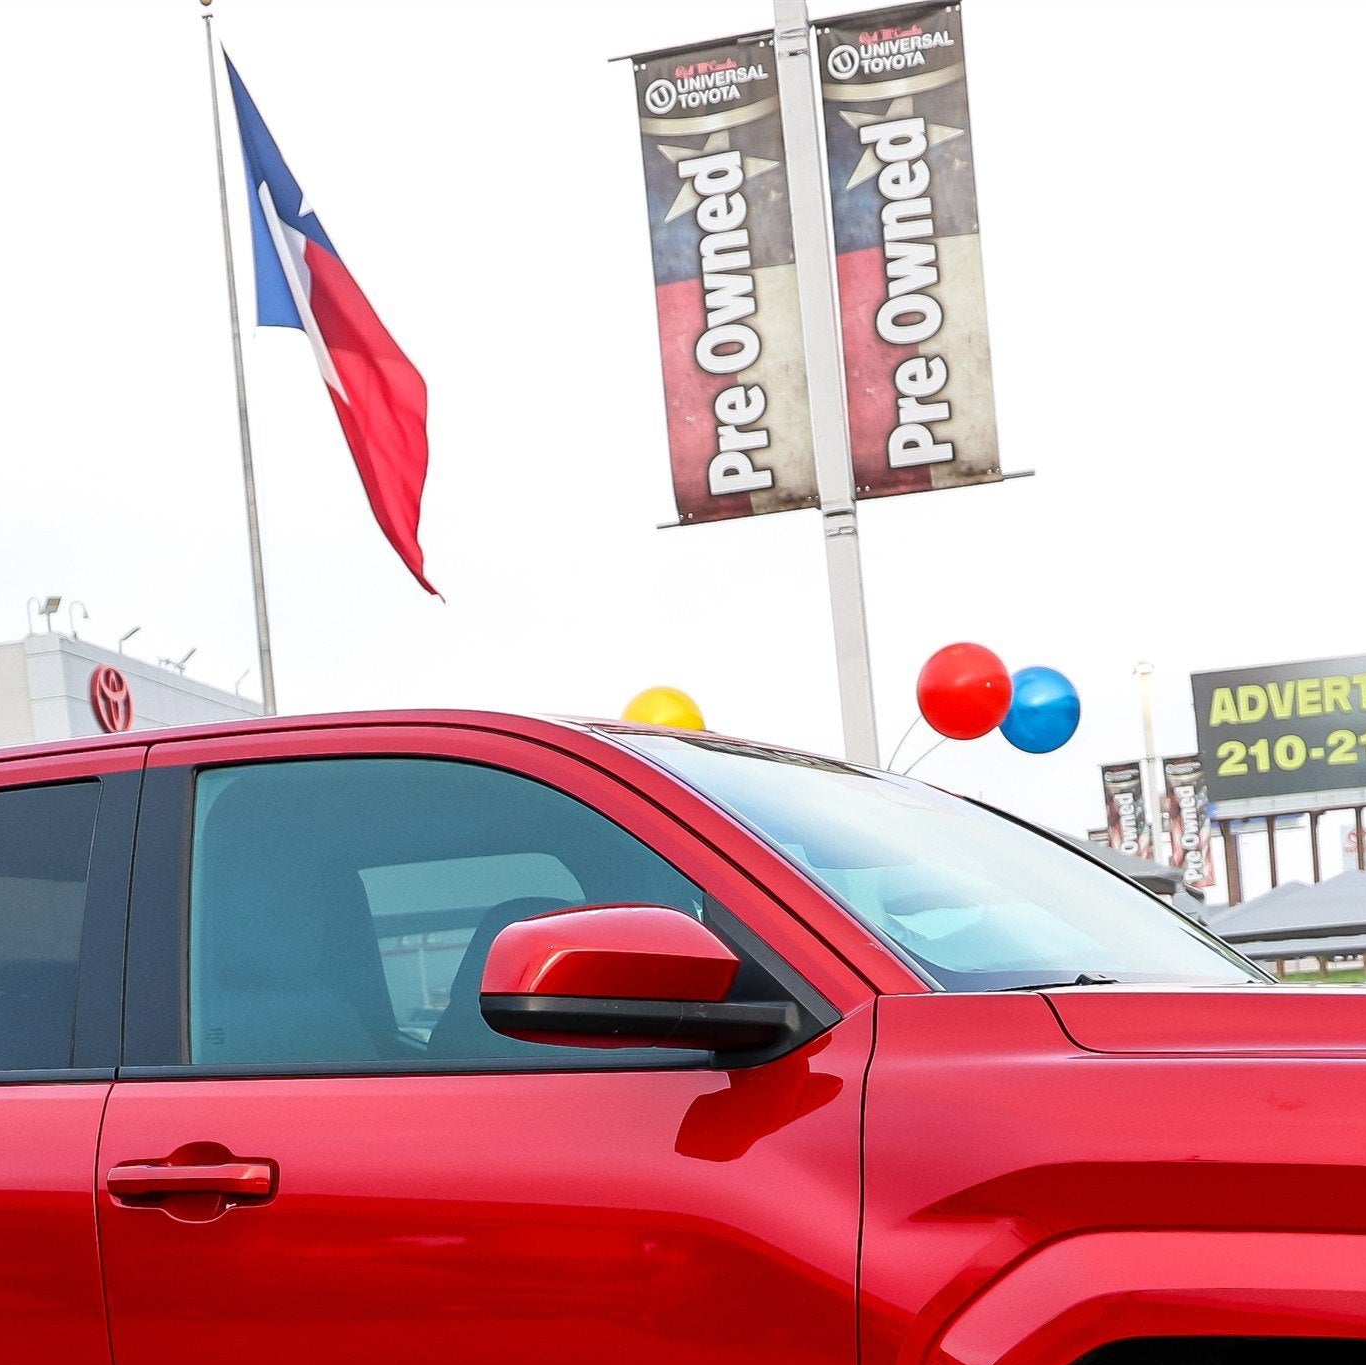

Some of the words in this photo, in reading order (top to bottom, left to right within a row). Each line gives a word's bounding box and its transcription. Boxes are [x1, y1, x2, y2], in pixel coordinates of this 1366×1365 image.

[860, 30, 955, 60] UNIVERSAL
[861, 50, 926, 75] TOYOTA
[676, 64, 769, 94] UNIVERSAL
[677, 84, 741, 110] TOYOTA
[678, 150, 762, 375] Owned
[859, 117, 944, 345] Owned
[708, 383, 775, 496] Pre
[887, 356, 955, 469] Pre
[1175, 785, 1200, 849] Owned
